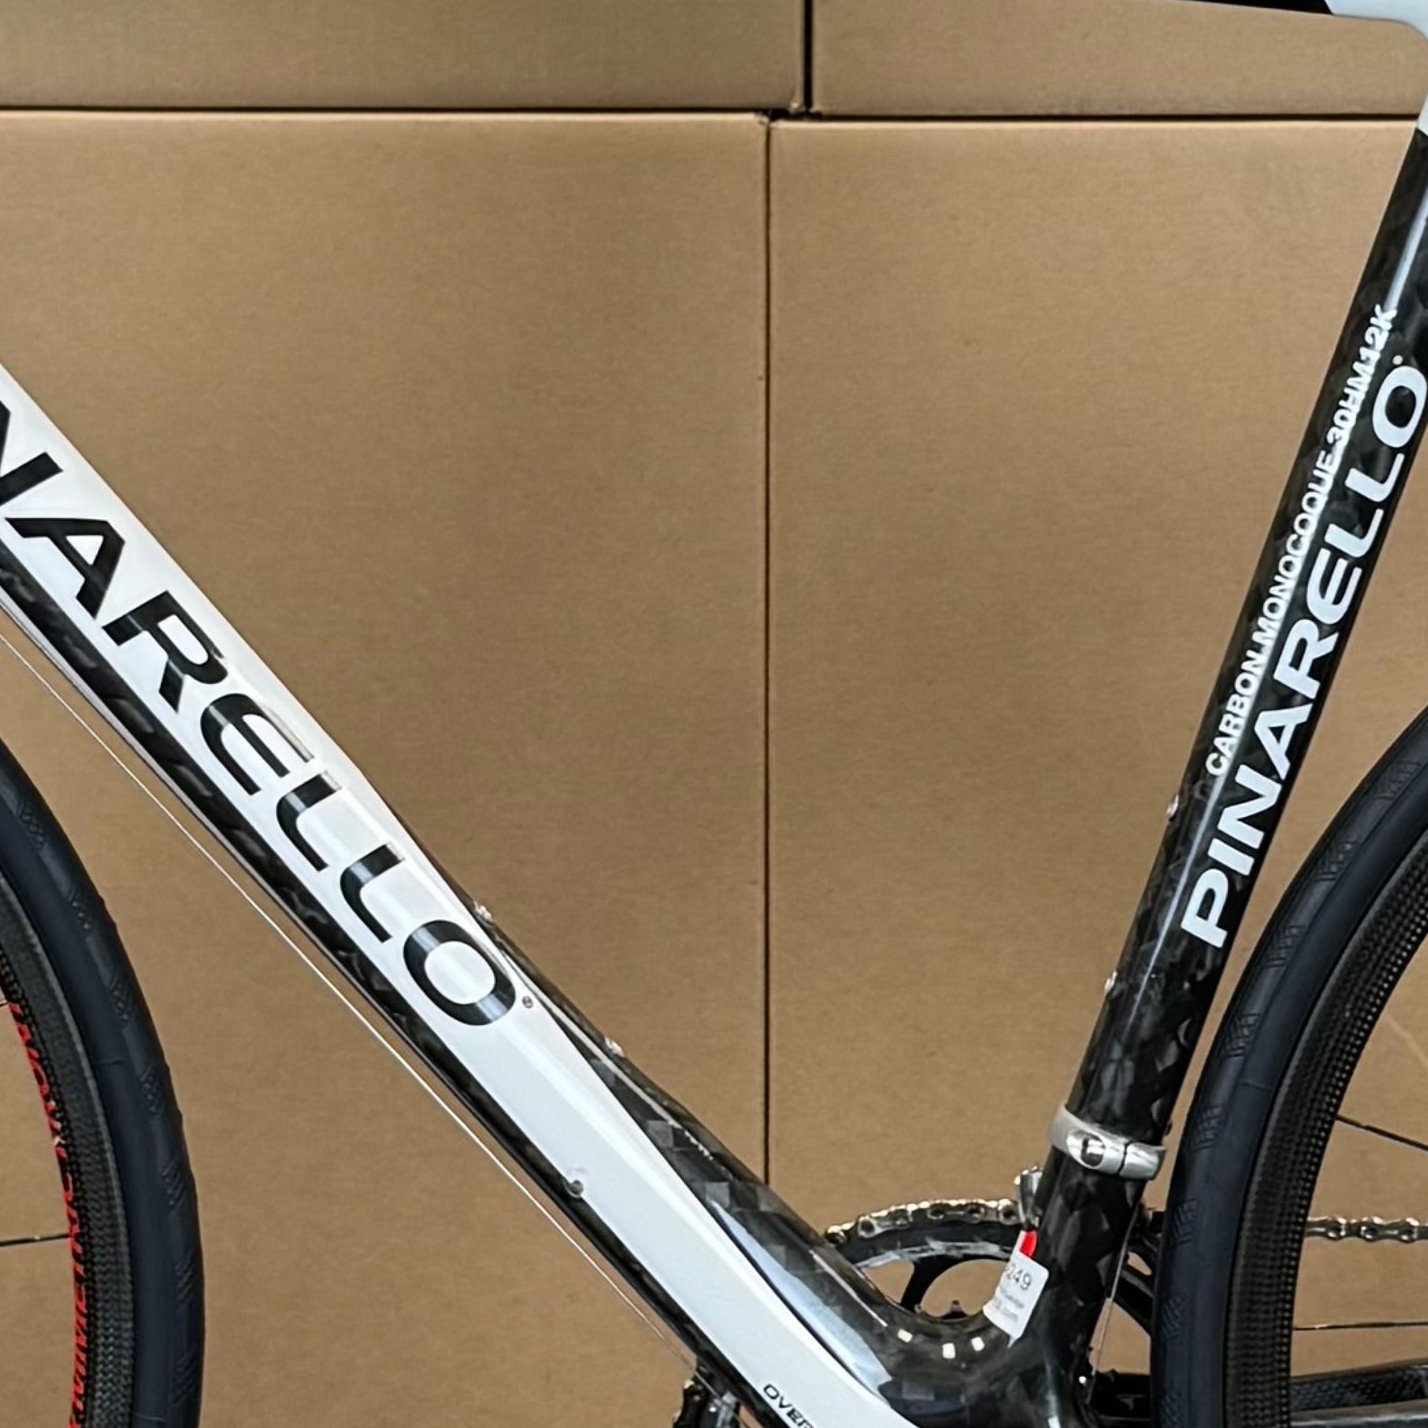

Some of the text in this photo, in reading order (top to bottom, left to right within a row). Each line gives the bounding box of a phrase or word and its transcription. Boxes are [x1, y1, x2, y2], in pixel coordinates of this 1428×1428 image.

[1180, 365, 1428, 948] PINARELLO
[1205, 648, 1269, 776] CARBON
[1252, 450, 1339, 649] MONOCOQUE
